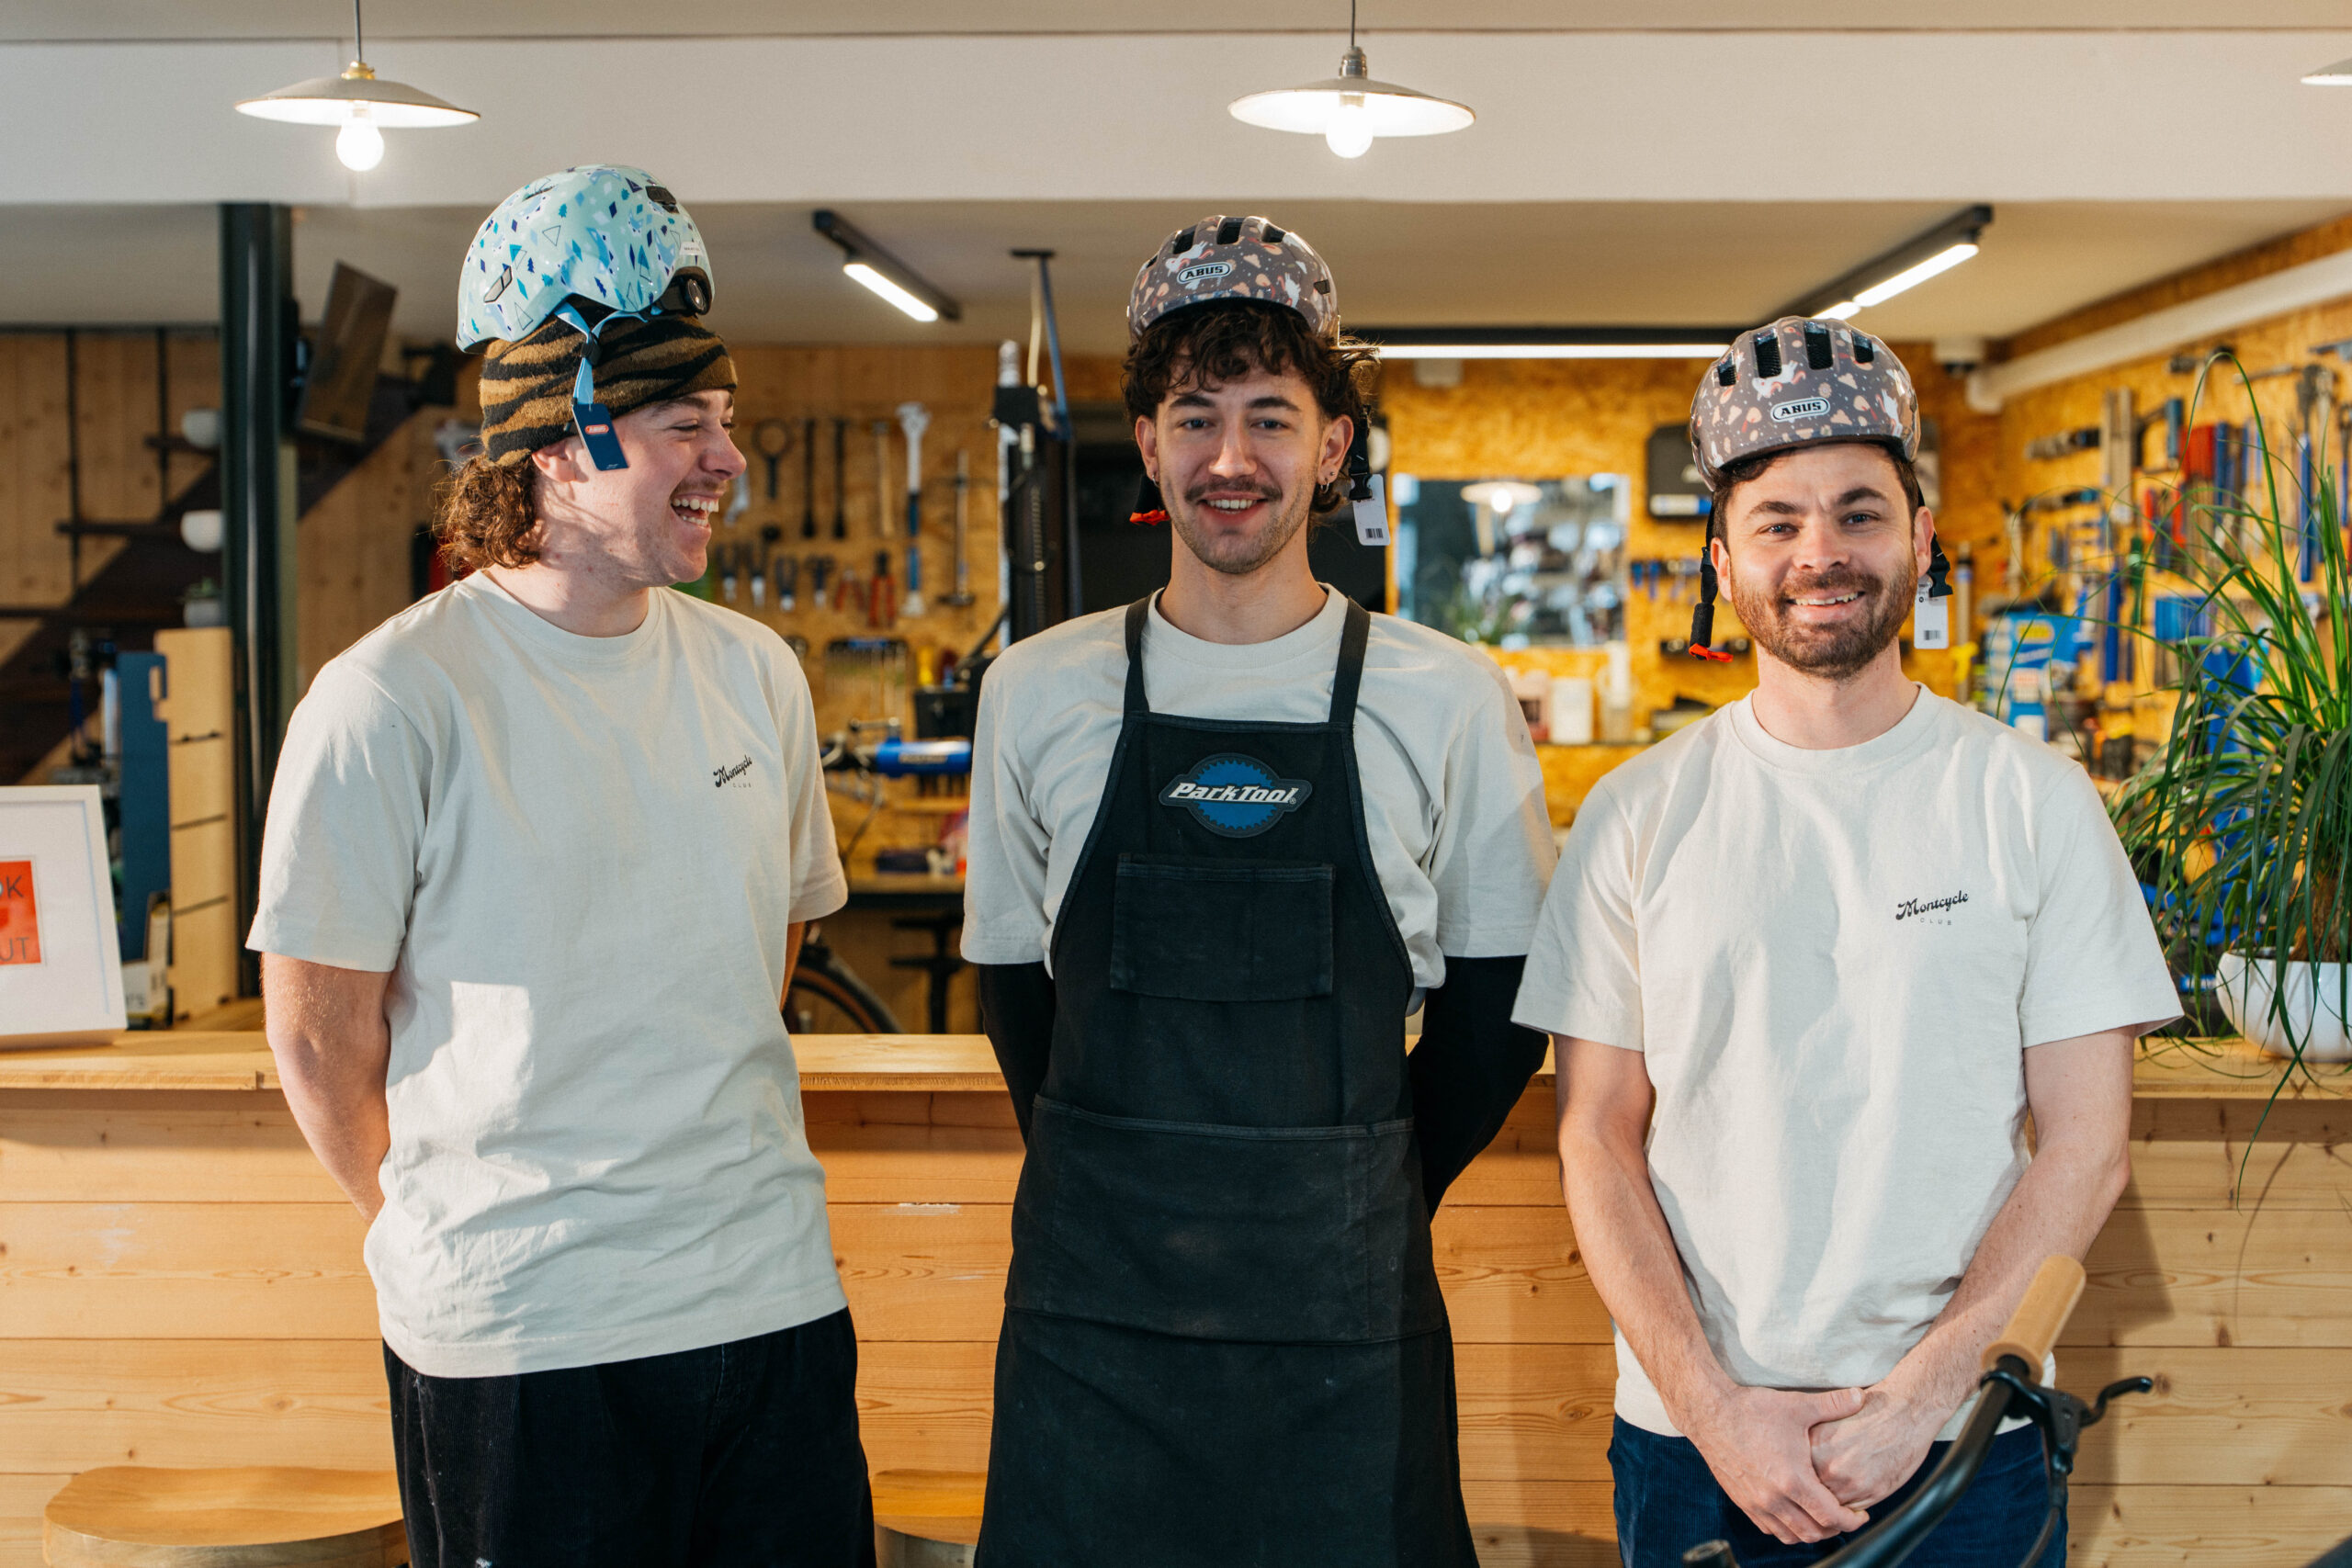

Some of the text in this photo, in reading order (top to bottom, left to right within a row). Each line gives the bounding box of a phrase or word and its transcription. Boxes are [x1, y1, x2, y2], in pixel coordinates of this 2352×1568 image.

[1184, 265, 1223, 279] ABUS
[1781, 401, 1821, 416] ABUS
[712, 754, 752, 788] Montcycle
[1168, 782, 1299, 805] ParkTool
[0, 874, 24, 898] K
[1895, 890, 1969, 920] Montcycle
